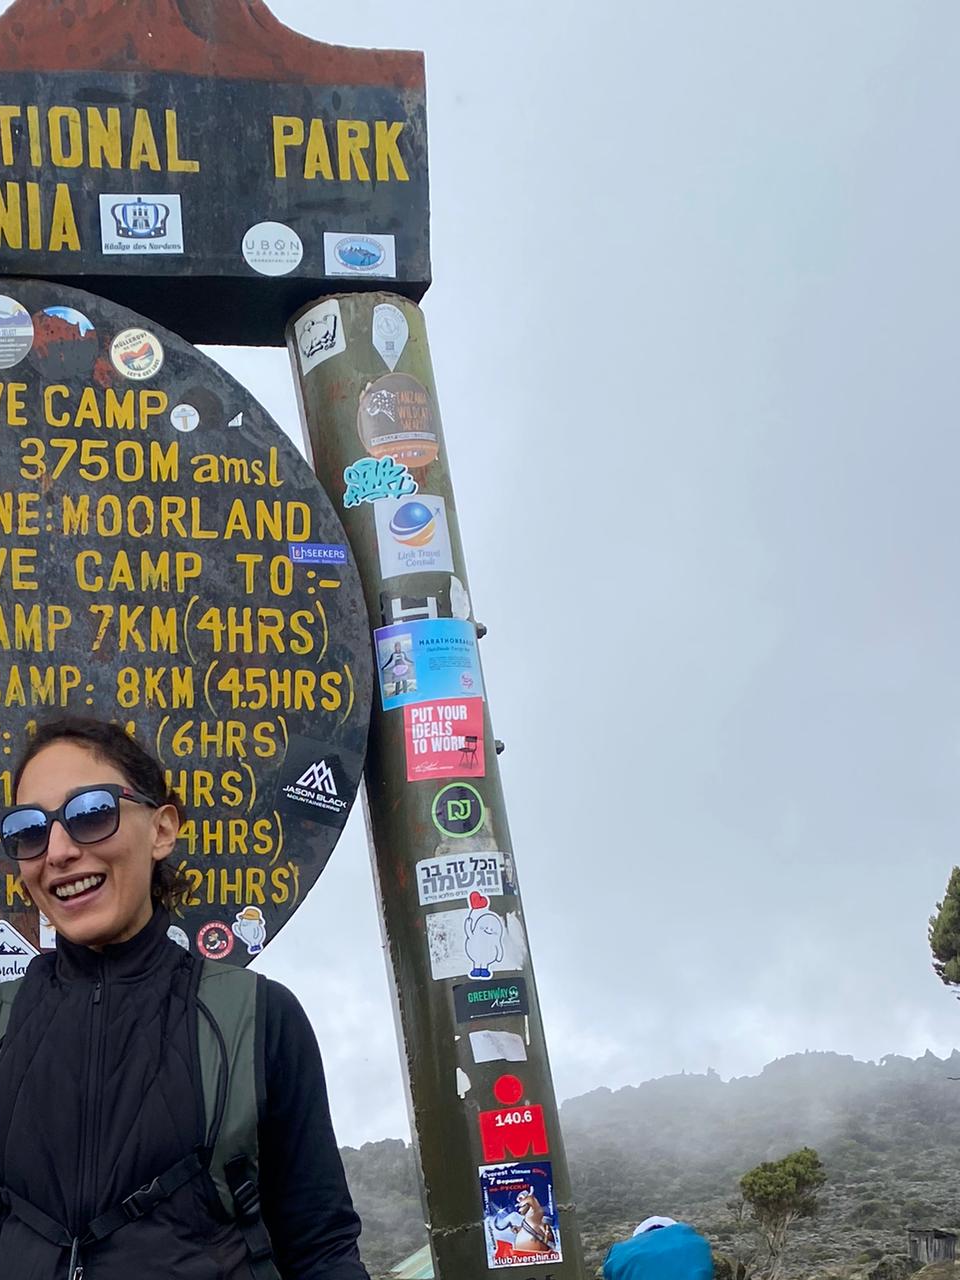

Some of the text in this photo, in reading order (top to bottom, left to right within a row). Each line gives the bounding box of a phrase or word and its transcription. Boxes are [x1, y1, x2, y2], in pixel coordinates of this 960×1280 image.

[272, 116, 408, 182] PARK
[43, 384, 169, 431] CAMP
[20, 438, 180, 483] 3750M
[191, 447, 282, 488] amsl
[61, 493, 312, 543] MOORLAND
[74, 549, 203, 593] CAMP
[88, 603, 178, 655] 7KM
[182, 595, 330, 666] (4HRS)
[116, 666, 195, 709] 8KM
[411, 704, 468, 723] PUT YOUR
[411, 721, 453, 739] IDEALS
[157, 714, 289, 764] (6HRS)
[412, 736, 466, 754] TO WORK
[282, 784, 348, 809] JASON BLACK
[286, 793, 341, 812] MOUNTAINEERING
[176, 810, 284, 866] 4HRS)
[421, 857, 498, 878] הכל זה בר
[422, 870, 499, 895] הגשמה
[495, 1110, 533, 1127] 140.6
